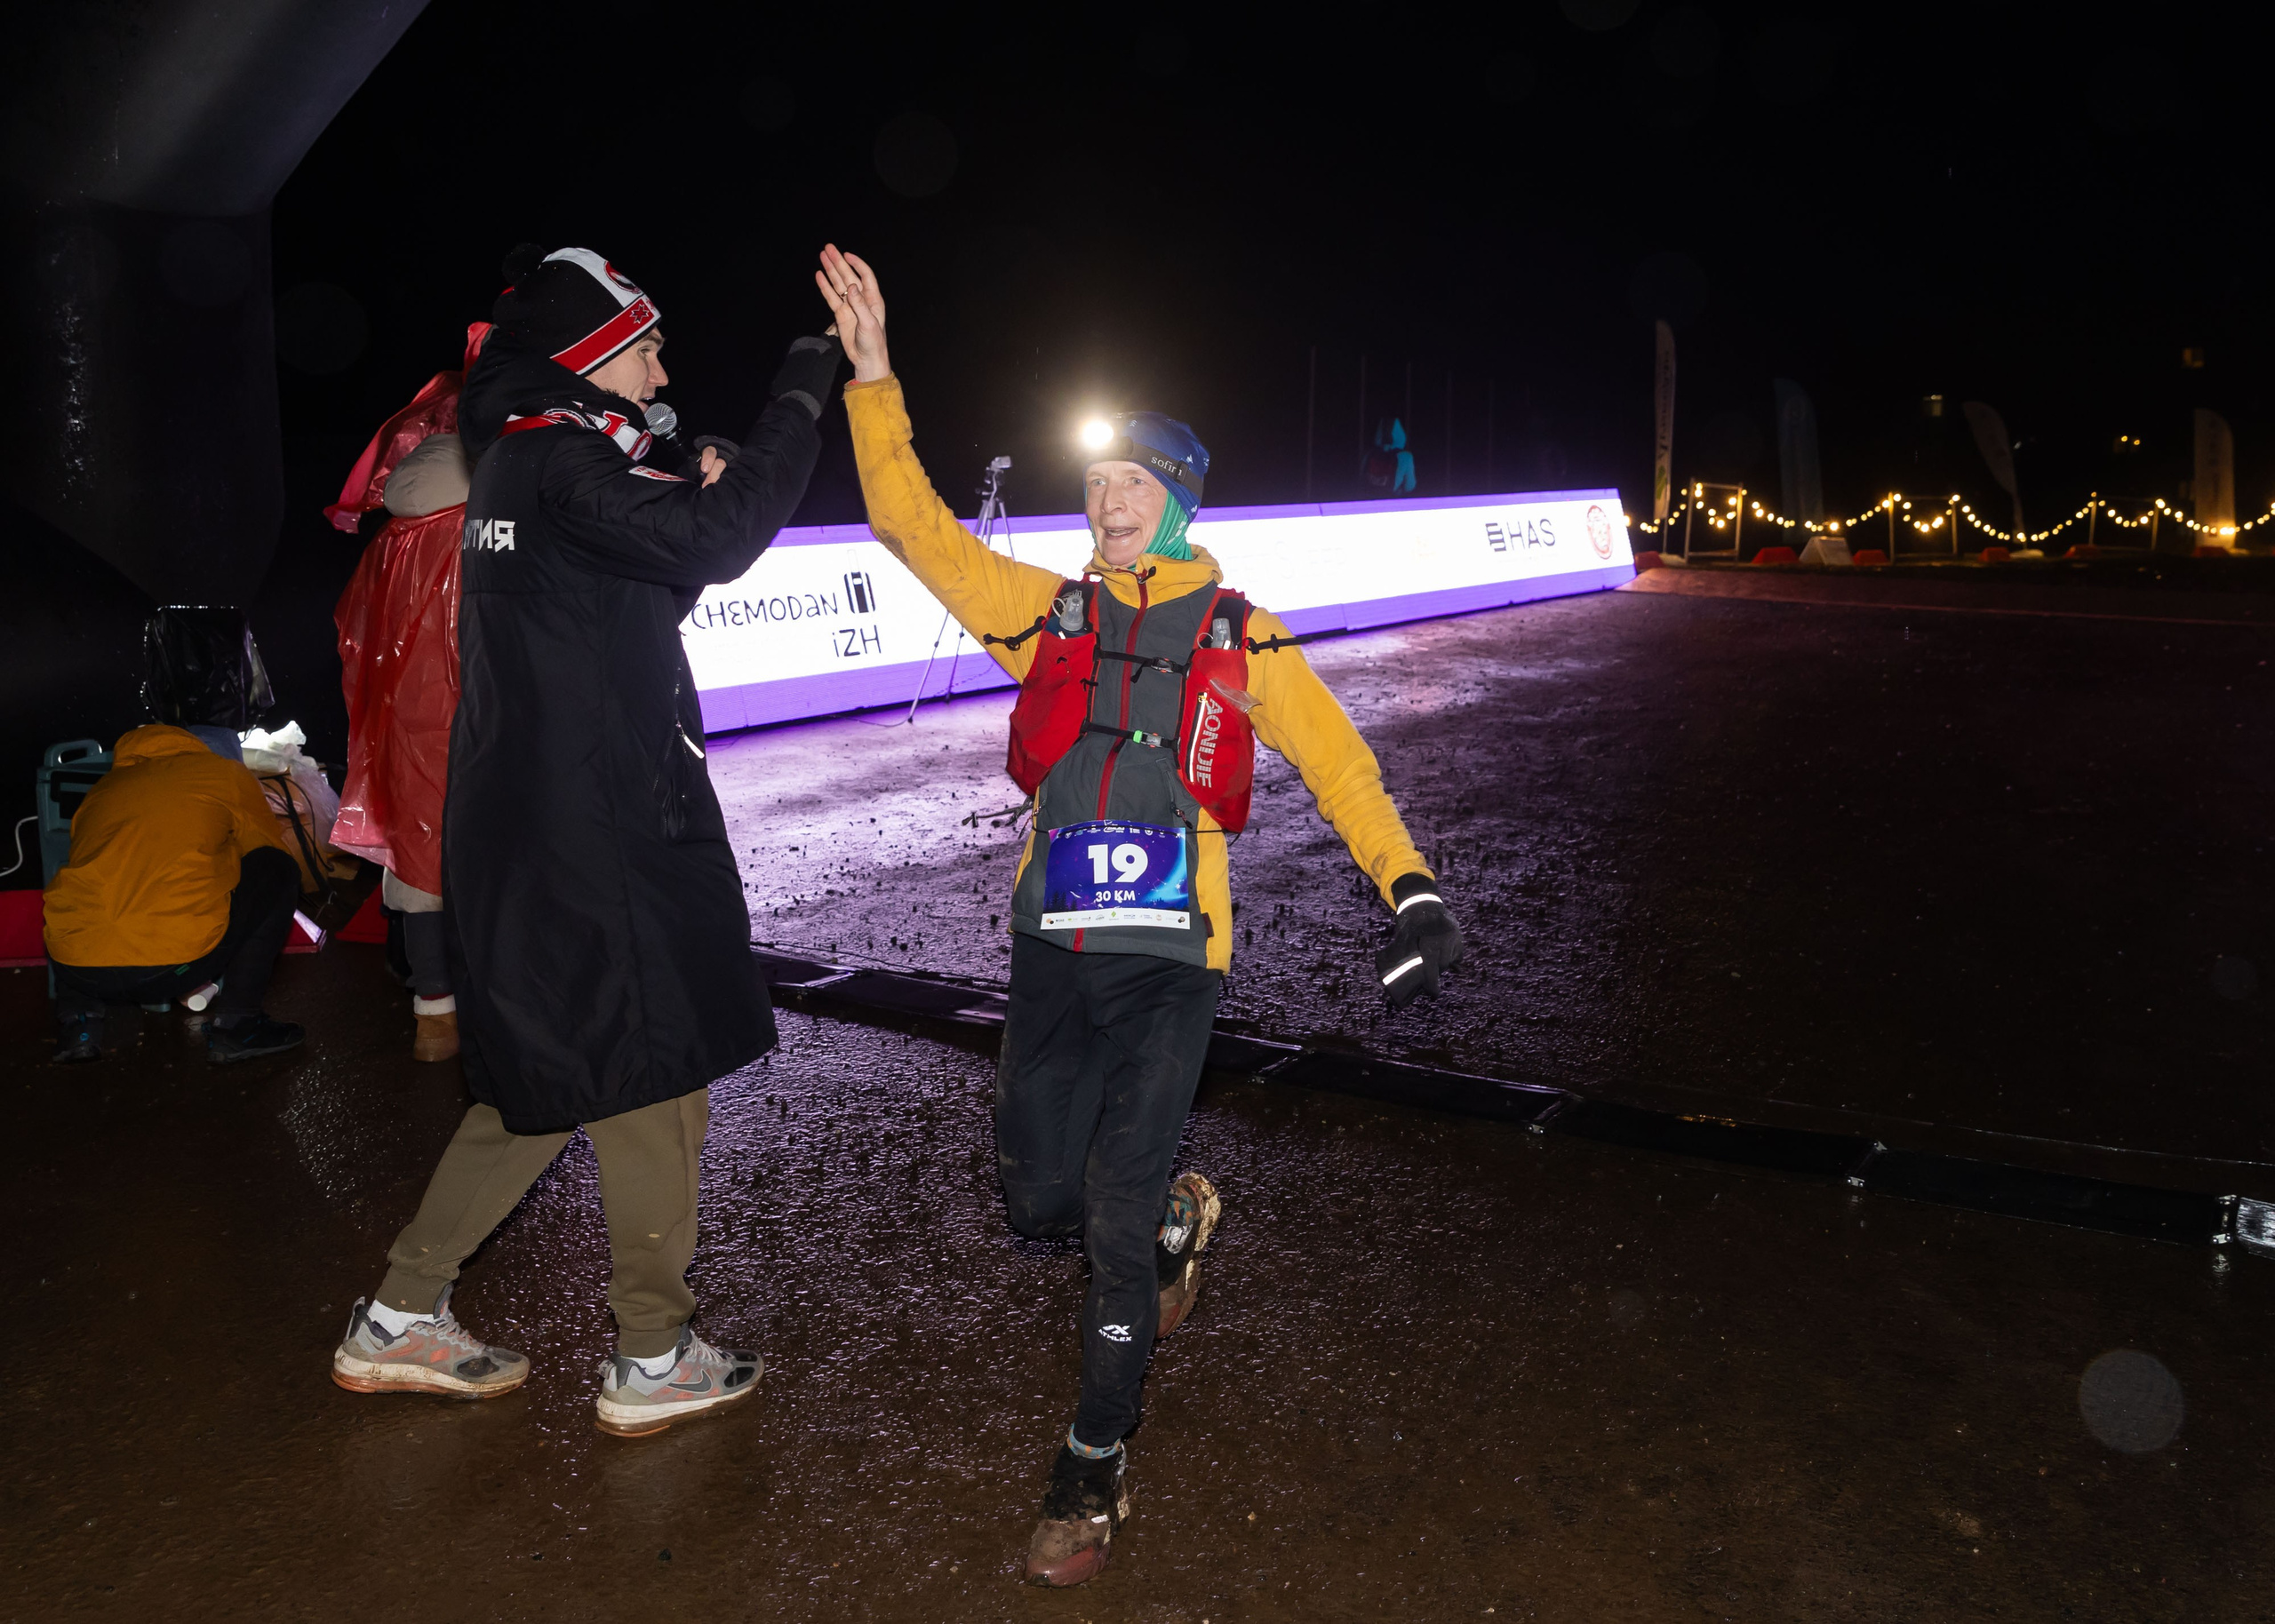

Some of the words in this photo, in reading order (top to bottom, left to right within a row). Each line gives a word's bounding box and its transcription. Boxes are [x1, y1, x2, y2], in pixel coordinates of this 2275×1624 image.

[1196, 697, 1224, 788] AONIJE
[1088, 843, 1148, 884] 19
[1095, 890, 1112, 903] 30
[1114, 889, 1136, 903] KM
